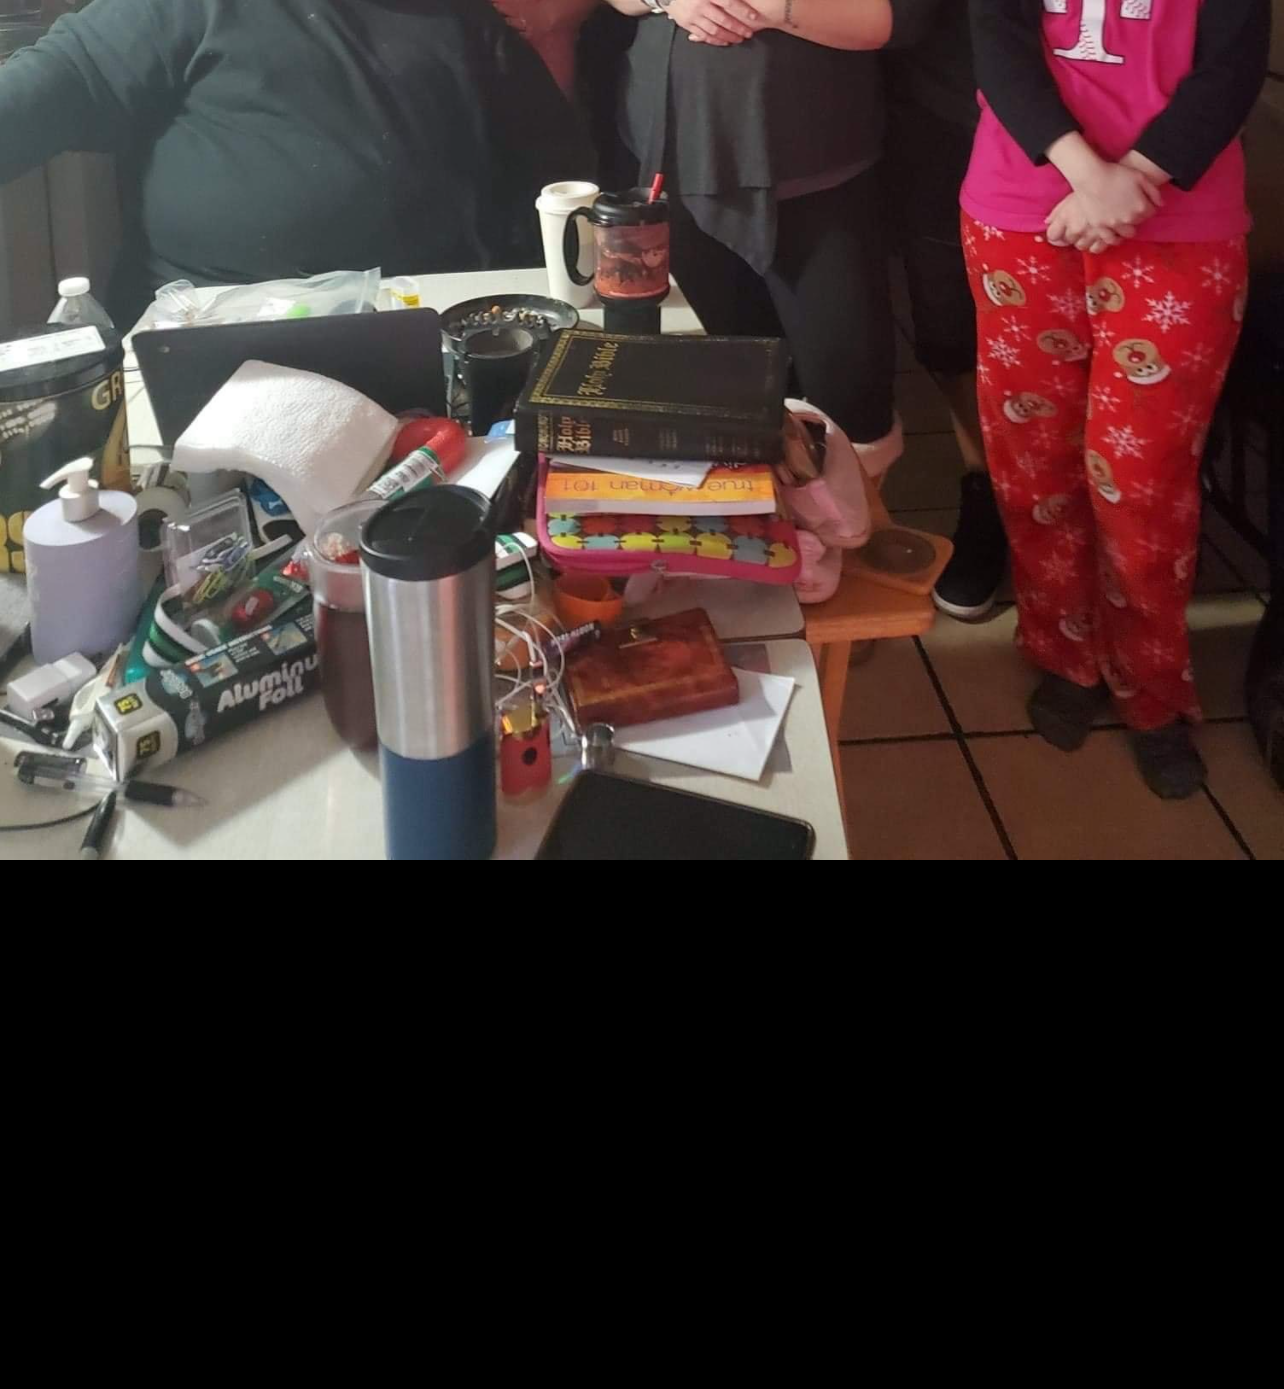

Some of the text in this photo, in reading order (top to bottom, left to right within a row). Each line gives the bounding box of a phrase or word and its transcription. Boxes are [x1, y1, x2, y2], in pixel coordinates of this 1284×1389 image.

[563, 478, 598, 492] 101
[708, 478, 754, 492] true
[217, 653, 321, 713] Aluminu
[259, 675, 304, 711] Foil
